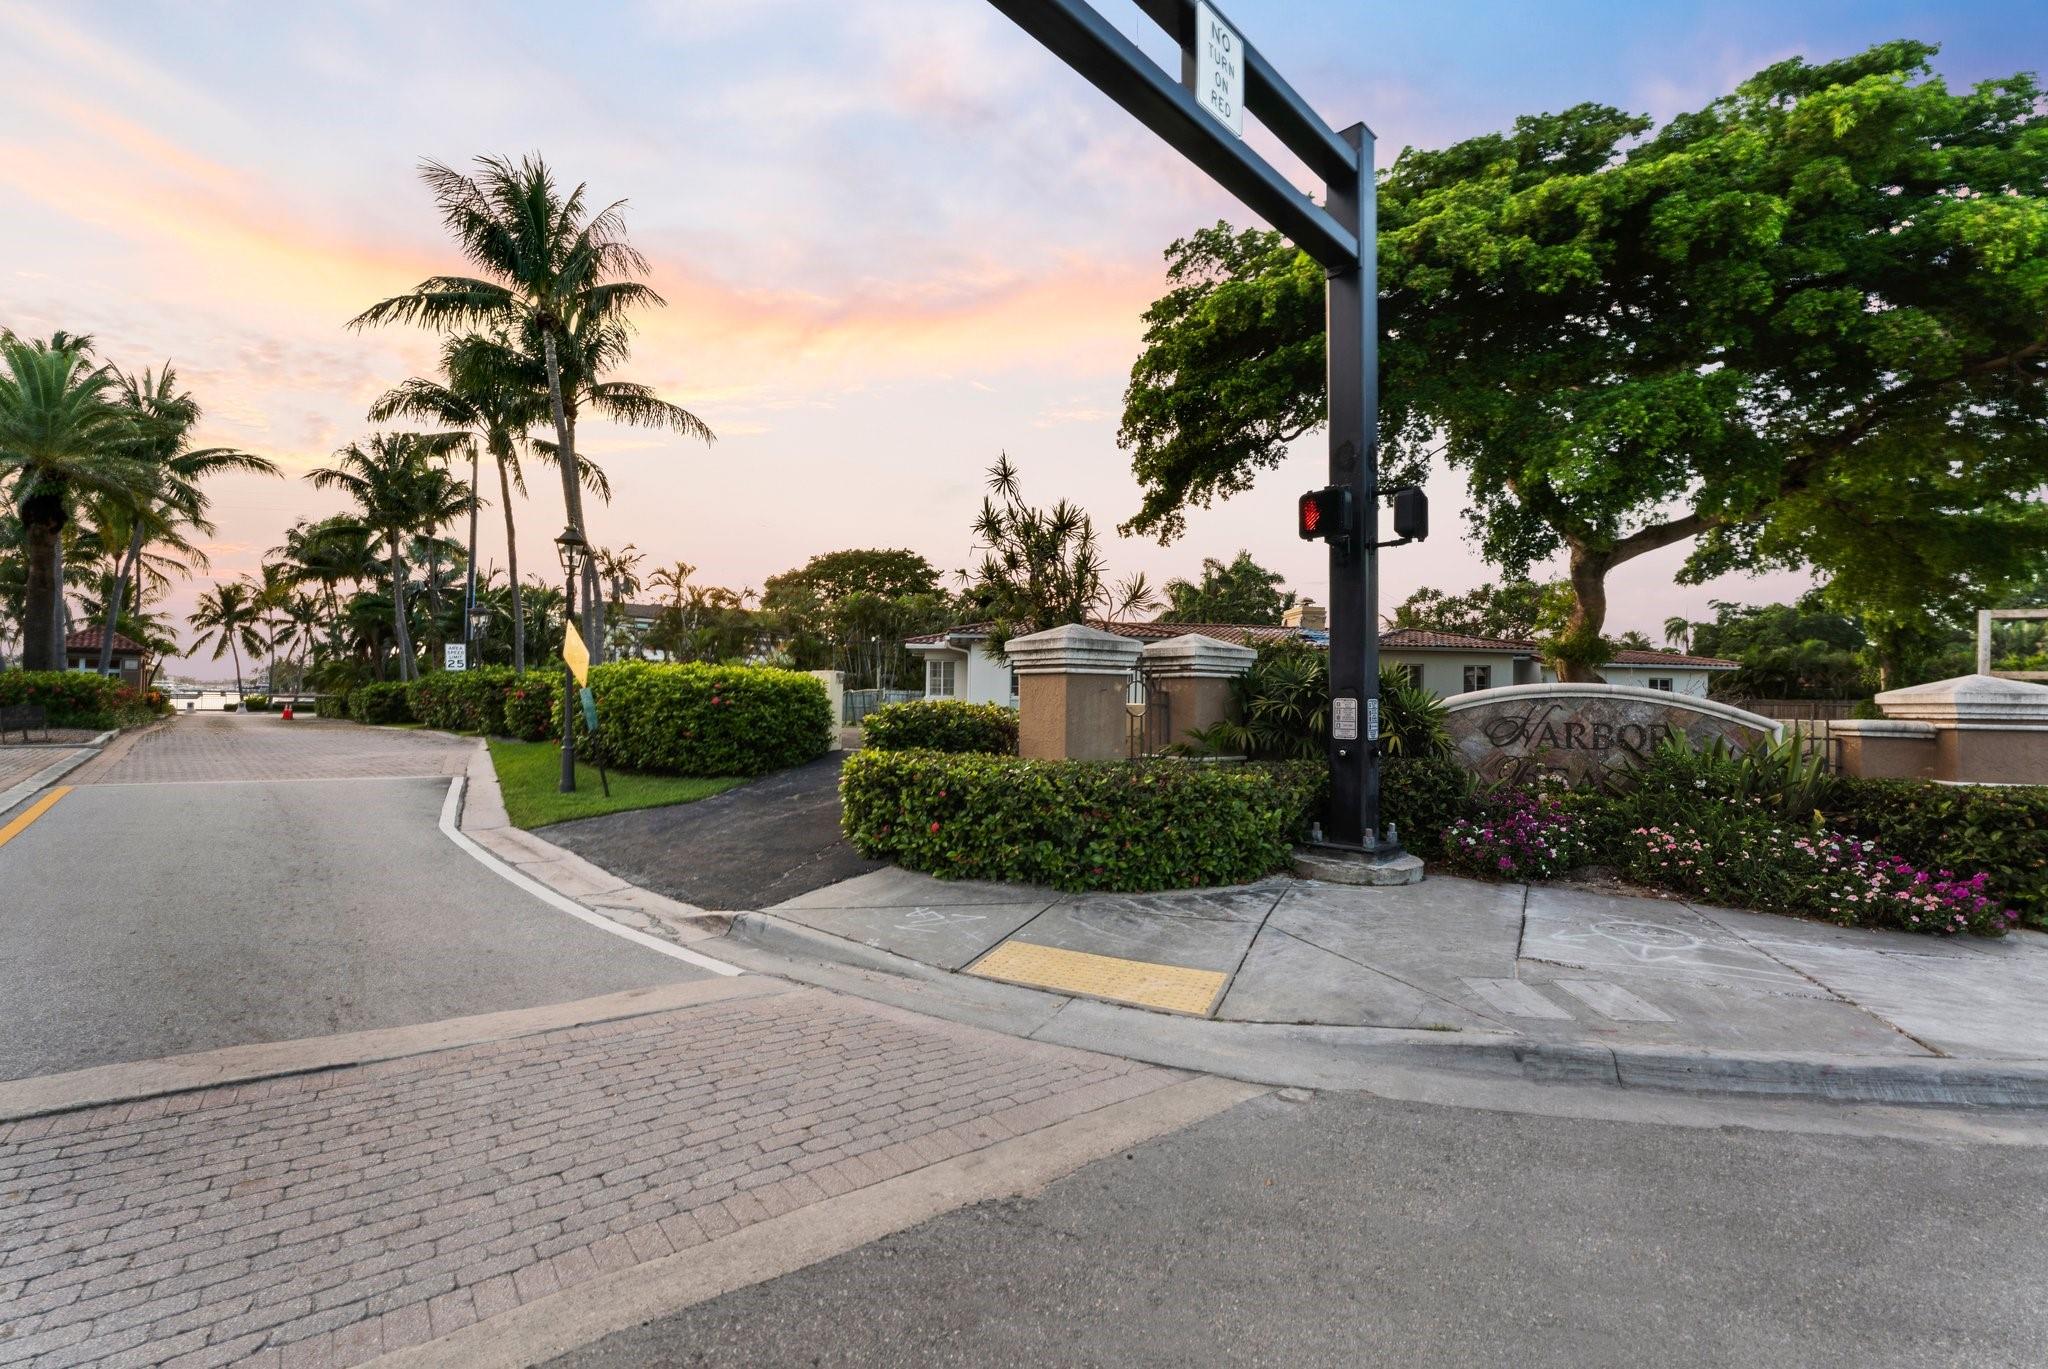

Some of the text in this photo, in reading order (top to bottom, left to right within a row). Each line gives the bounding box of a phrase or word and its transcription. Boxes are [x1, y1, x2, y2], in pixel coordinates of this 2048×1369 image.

[1211, 21, 1231, 53] NO
[1208, 41, 1235, 80] TURN
[1215, 71, 1228, 95] ON
[1211, 89, 1231, 118] RED
[448, 660, 464, 668] 25
